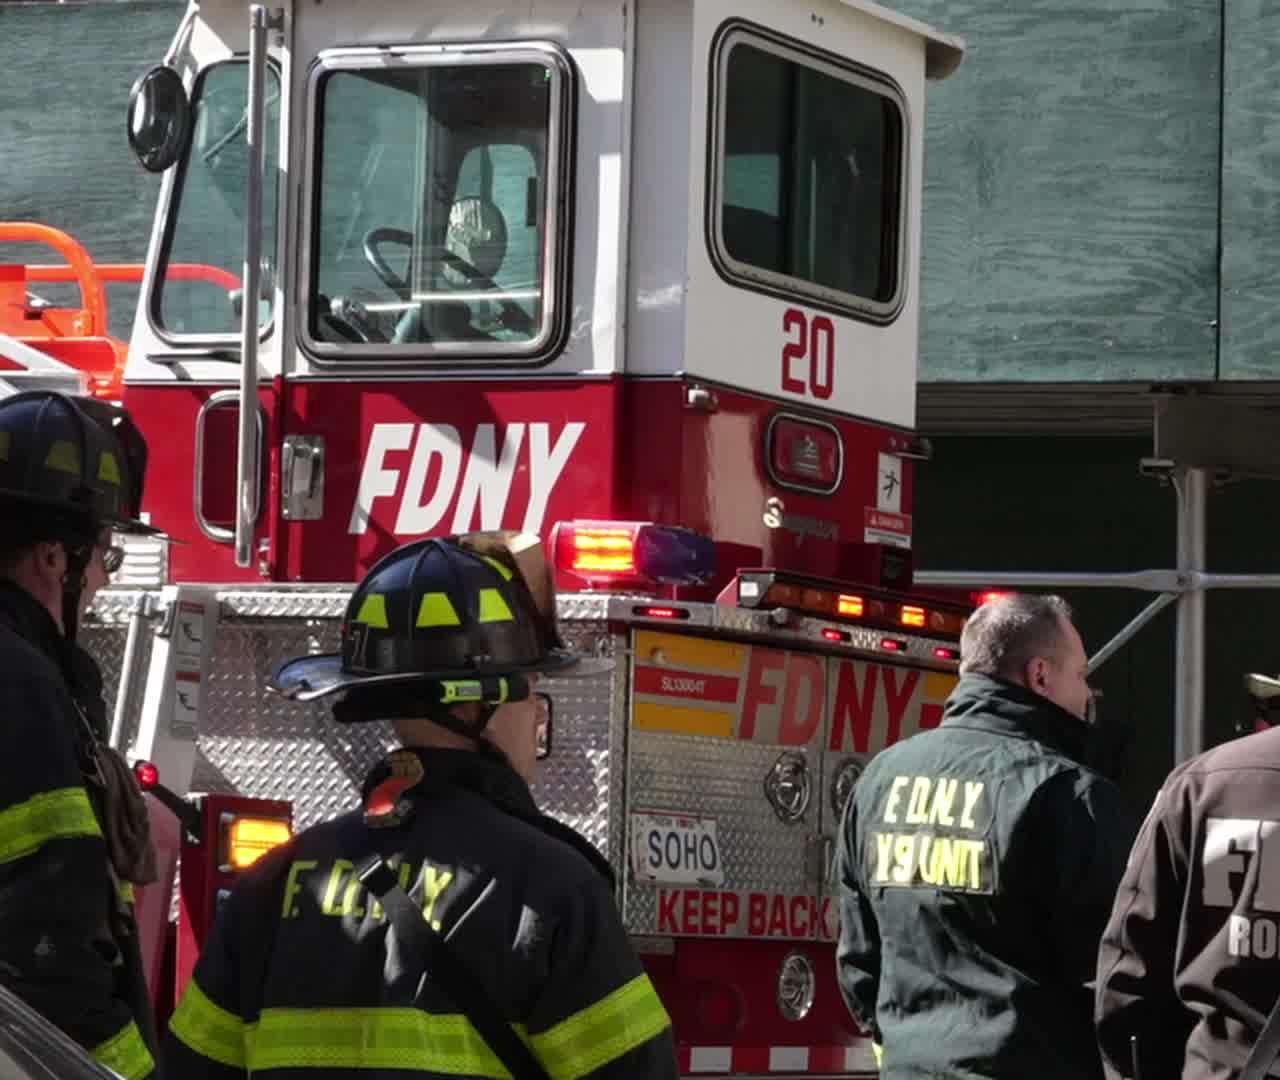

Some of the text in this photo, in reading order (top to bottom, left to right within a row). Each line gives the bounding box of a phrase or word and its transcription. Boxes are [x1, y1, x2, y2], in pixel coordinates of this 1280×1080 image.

[782, 308, 835, 400] 20
[347, 422, 585, 536] FDNY
[737, 649, 922, 753] FDNY
[648, 829, 717, 871] SOHO
[919, 836, 985, 889] UNIT
[657, 888, 832, 940] KEEP BACK
